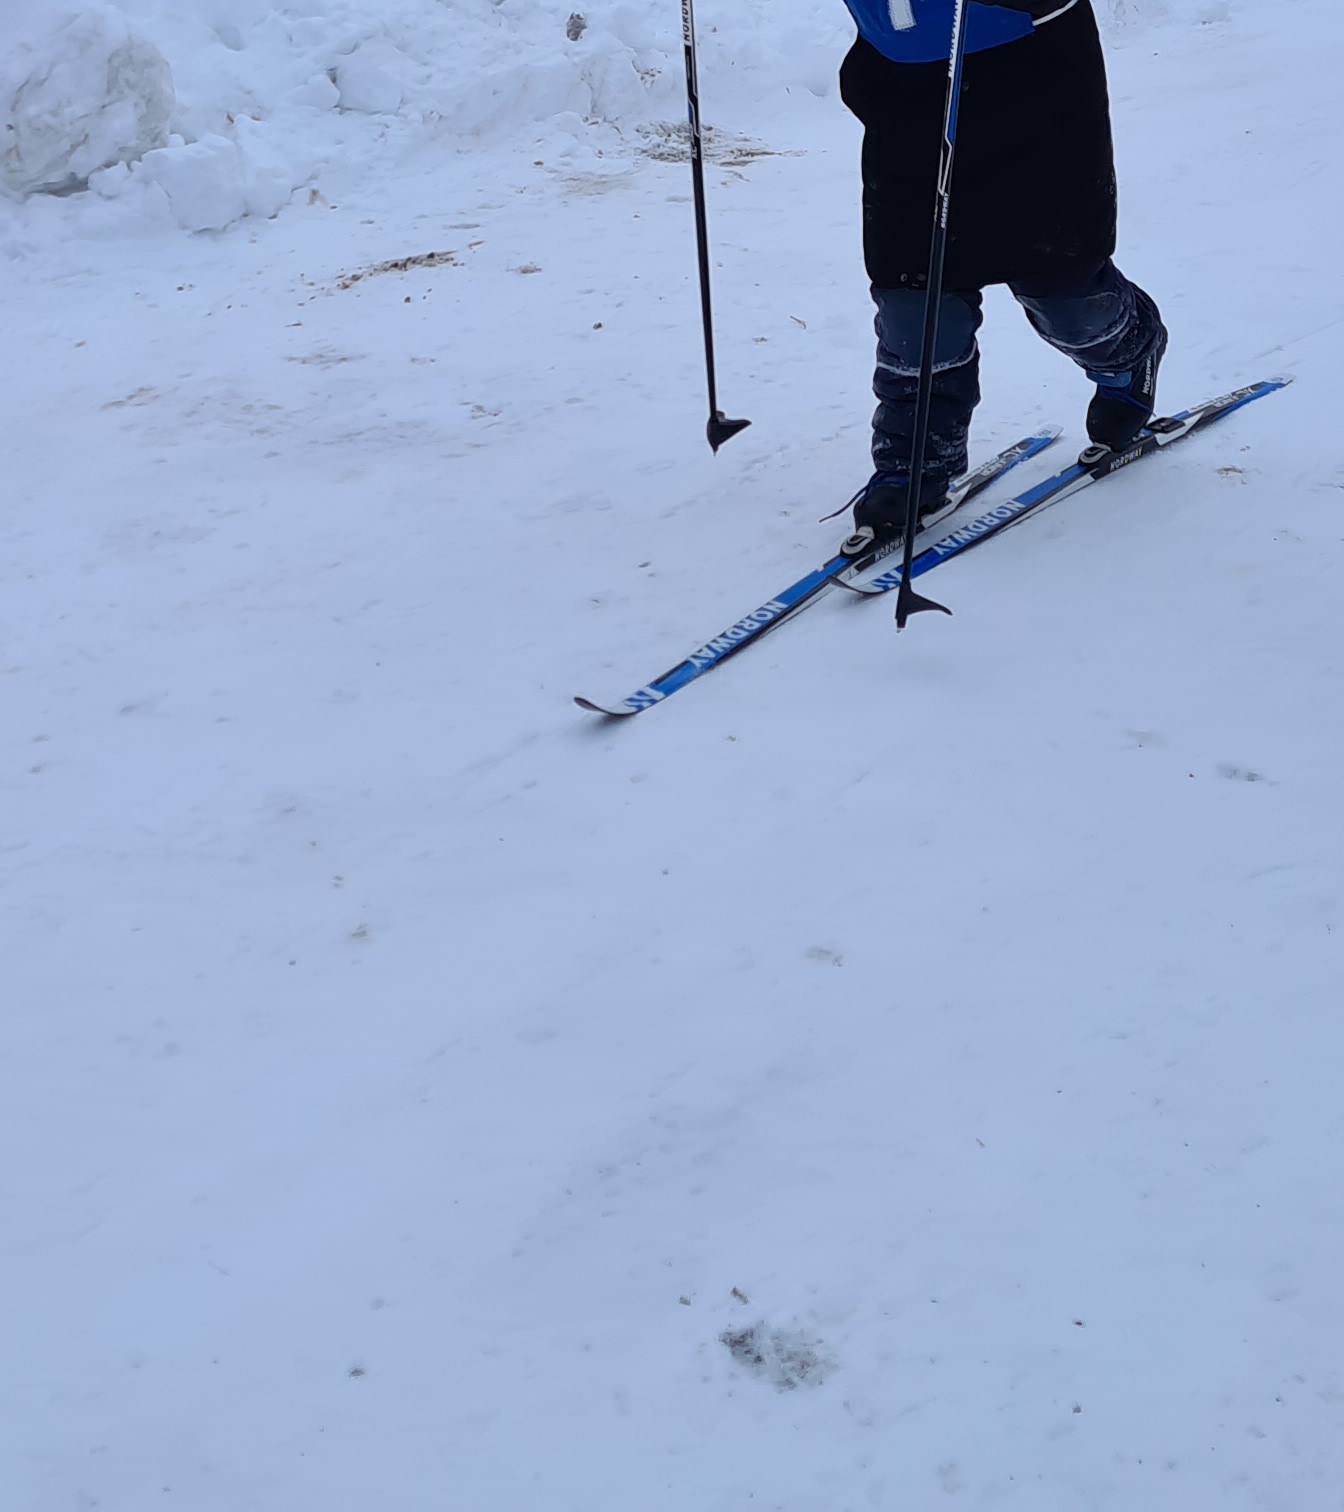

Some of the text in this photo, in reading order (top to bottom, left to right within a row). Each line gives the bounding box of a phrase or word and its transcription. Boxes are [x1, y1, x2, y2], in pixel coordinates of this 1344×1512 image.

[1110, 446, 1144, 471] NORDWAY
[874, 534, 906, 562] NORDWA
[931, 499, 1026, 556] NORDWAY
[687, 599, 790, 669] NORDWAY
